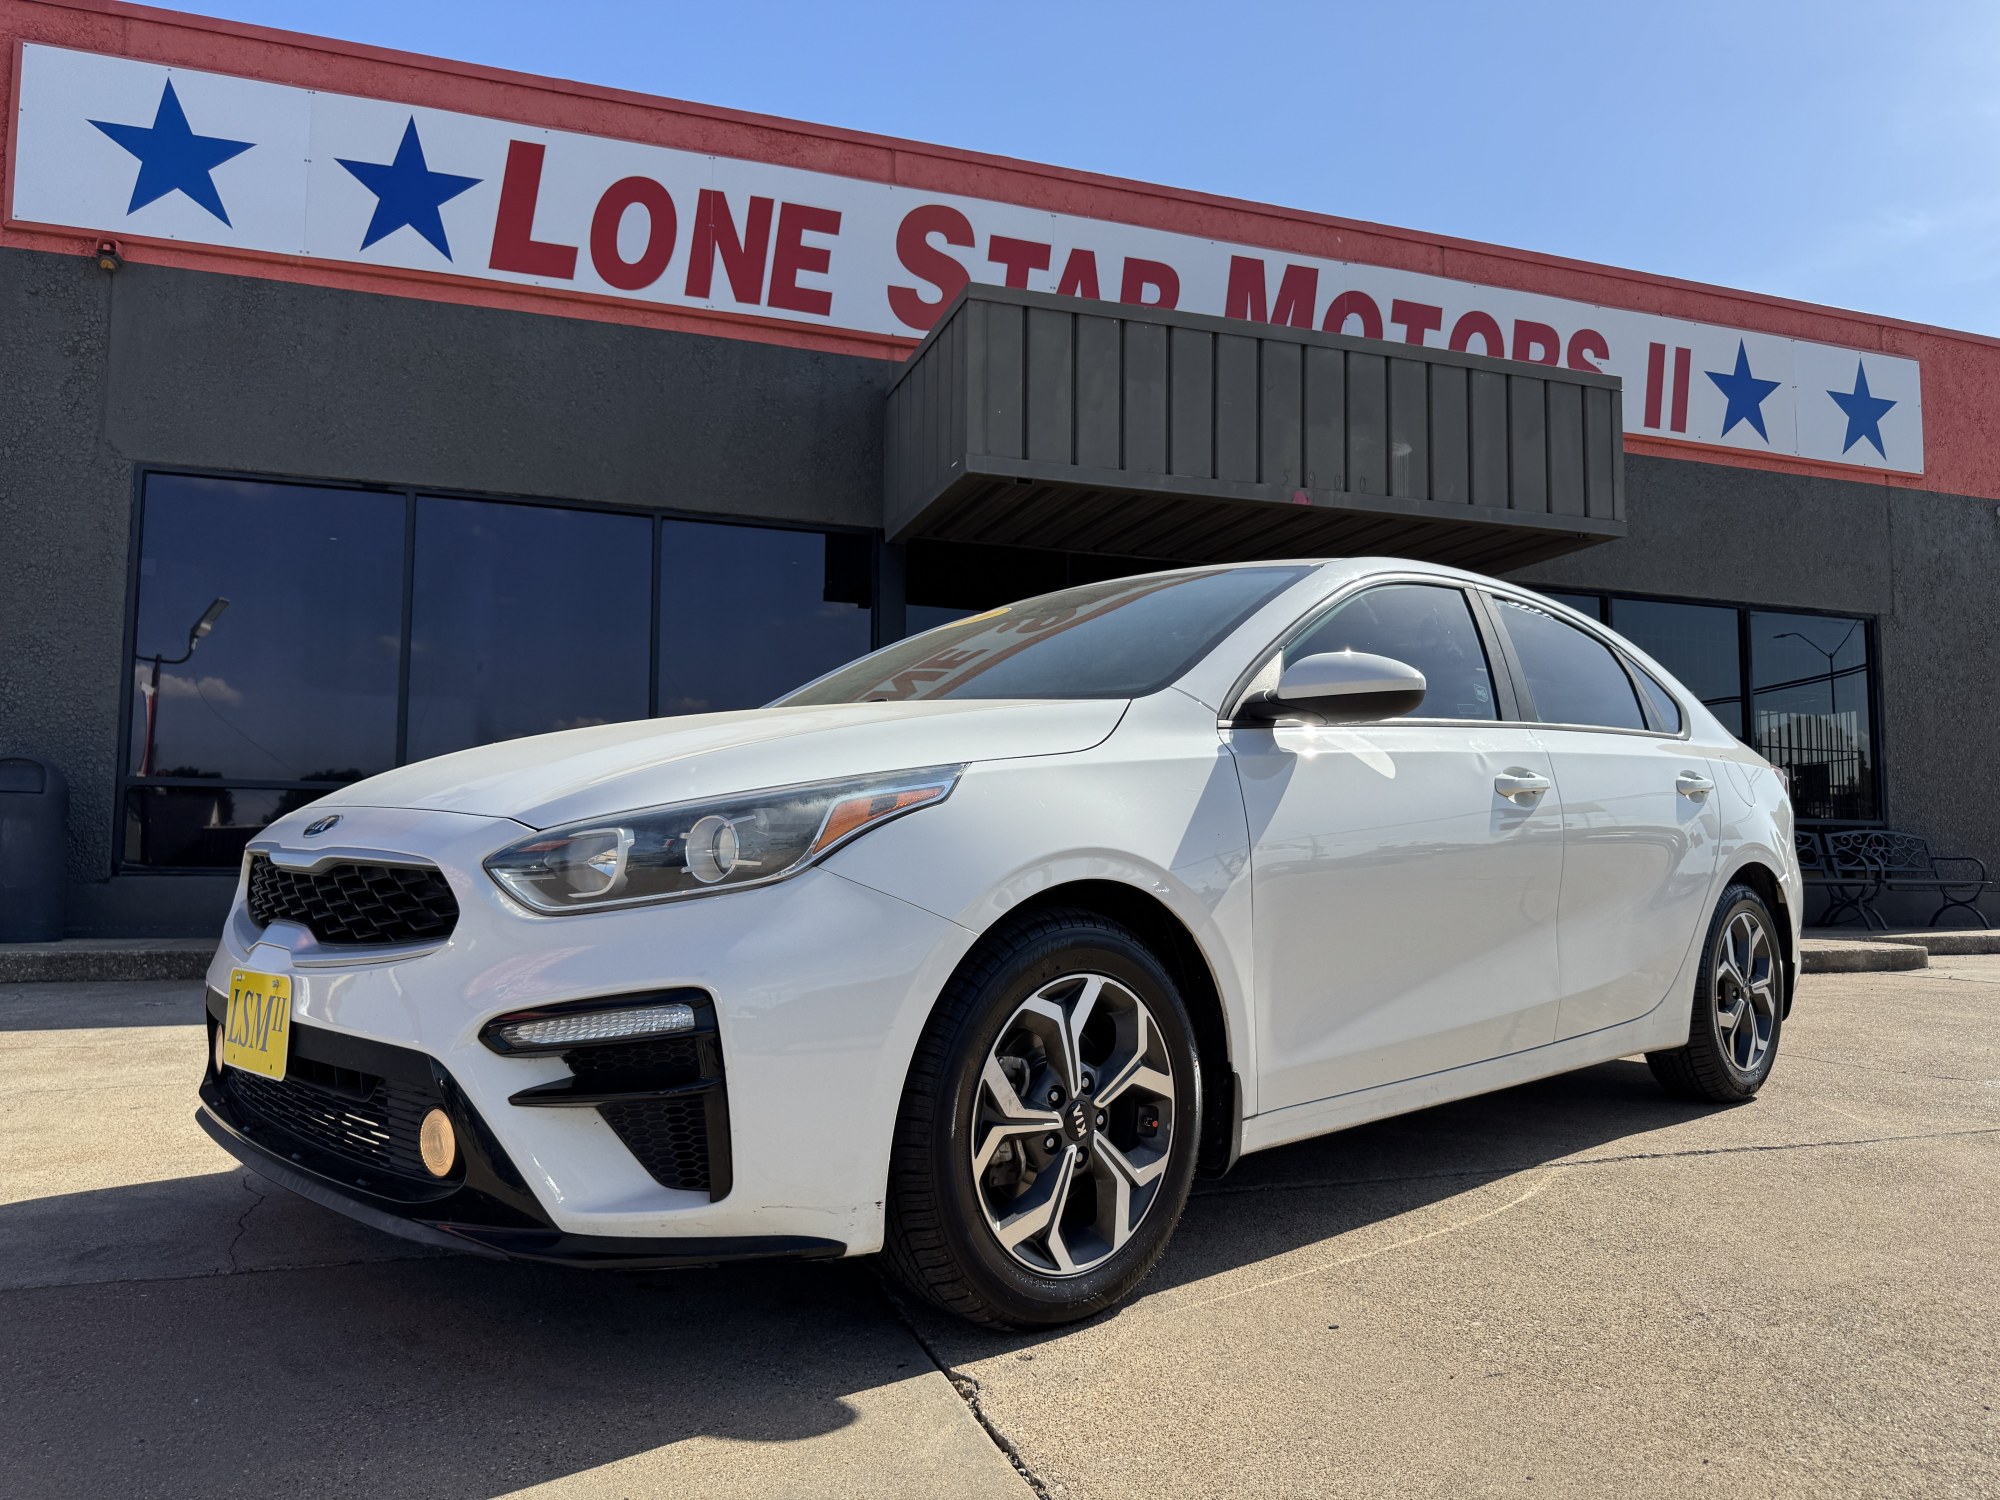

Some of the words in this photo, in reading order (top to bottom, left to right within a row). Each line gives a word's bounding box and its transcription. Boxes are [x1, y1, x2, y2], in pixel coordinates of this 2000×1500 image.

[489, 139, 842, 316] LONE
[1644, 342, 1691, 433] II
[1072, 1103, 1088, 1138] KIA
